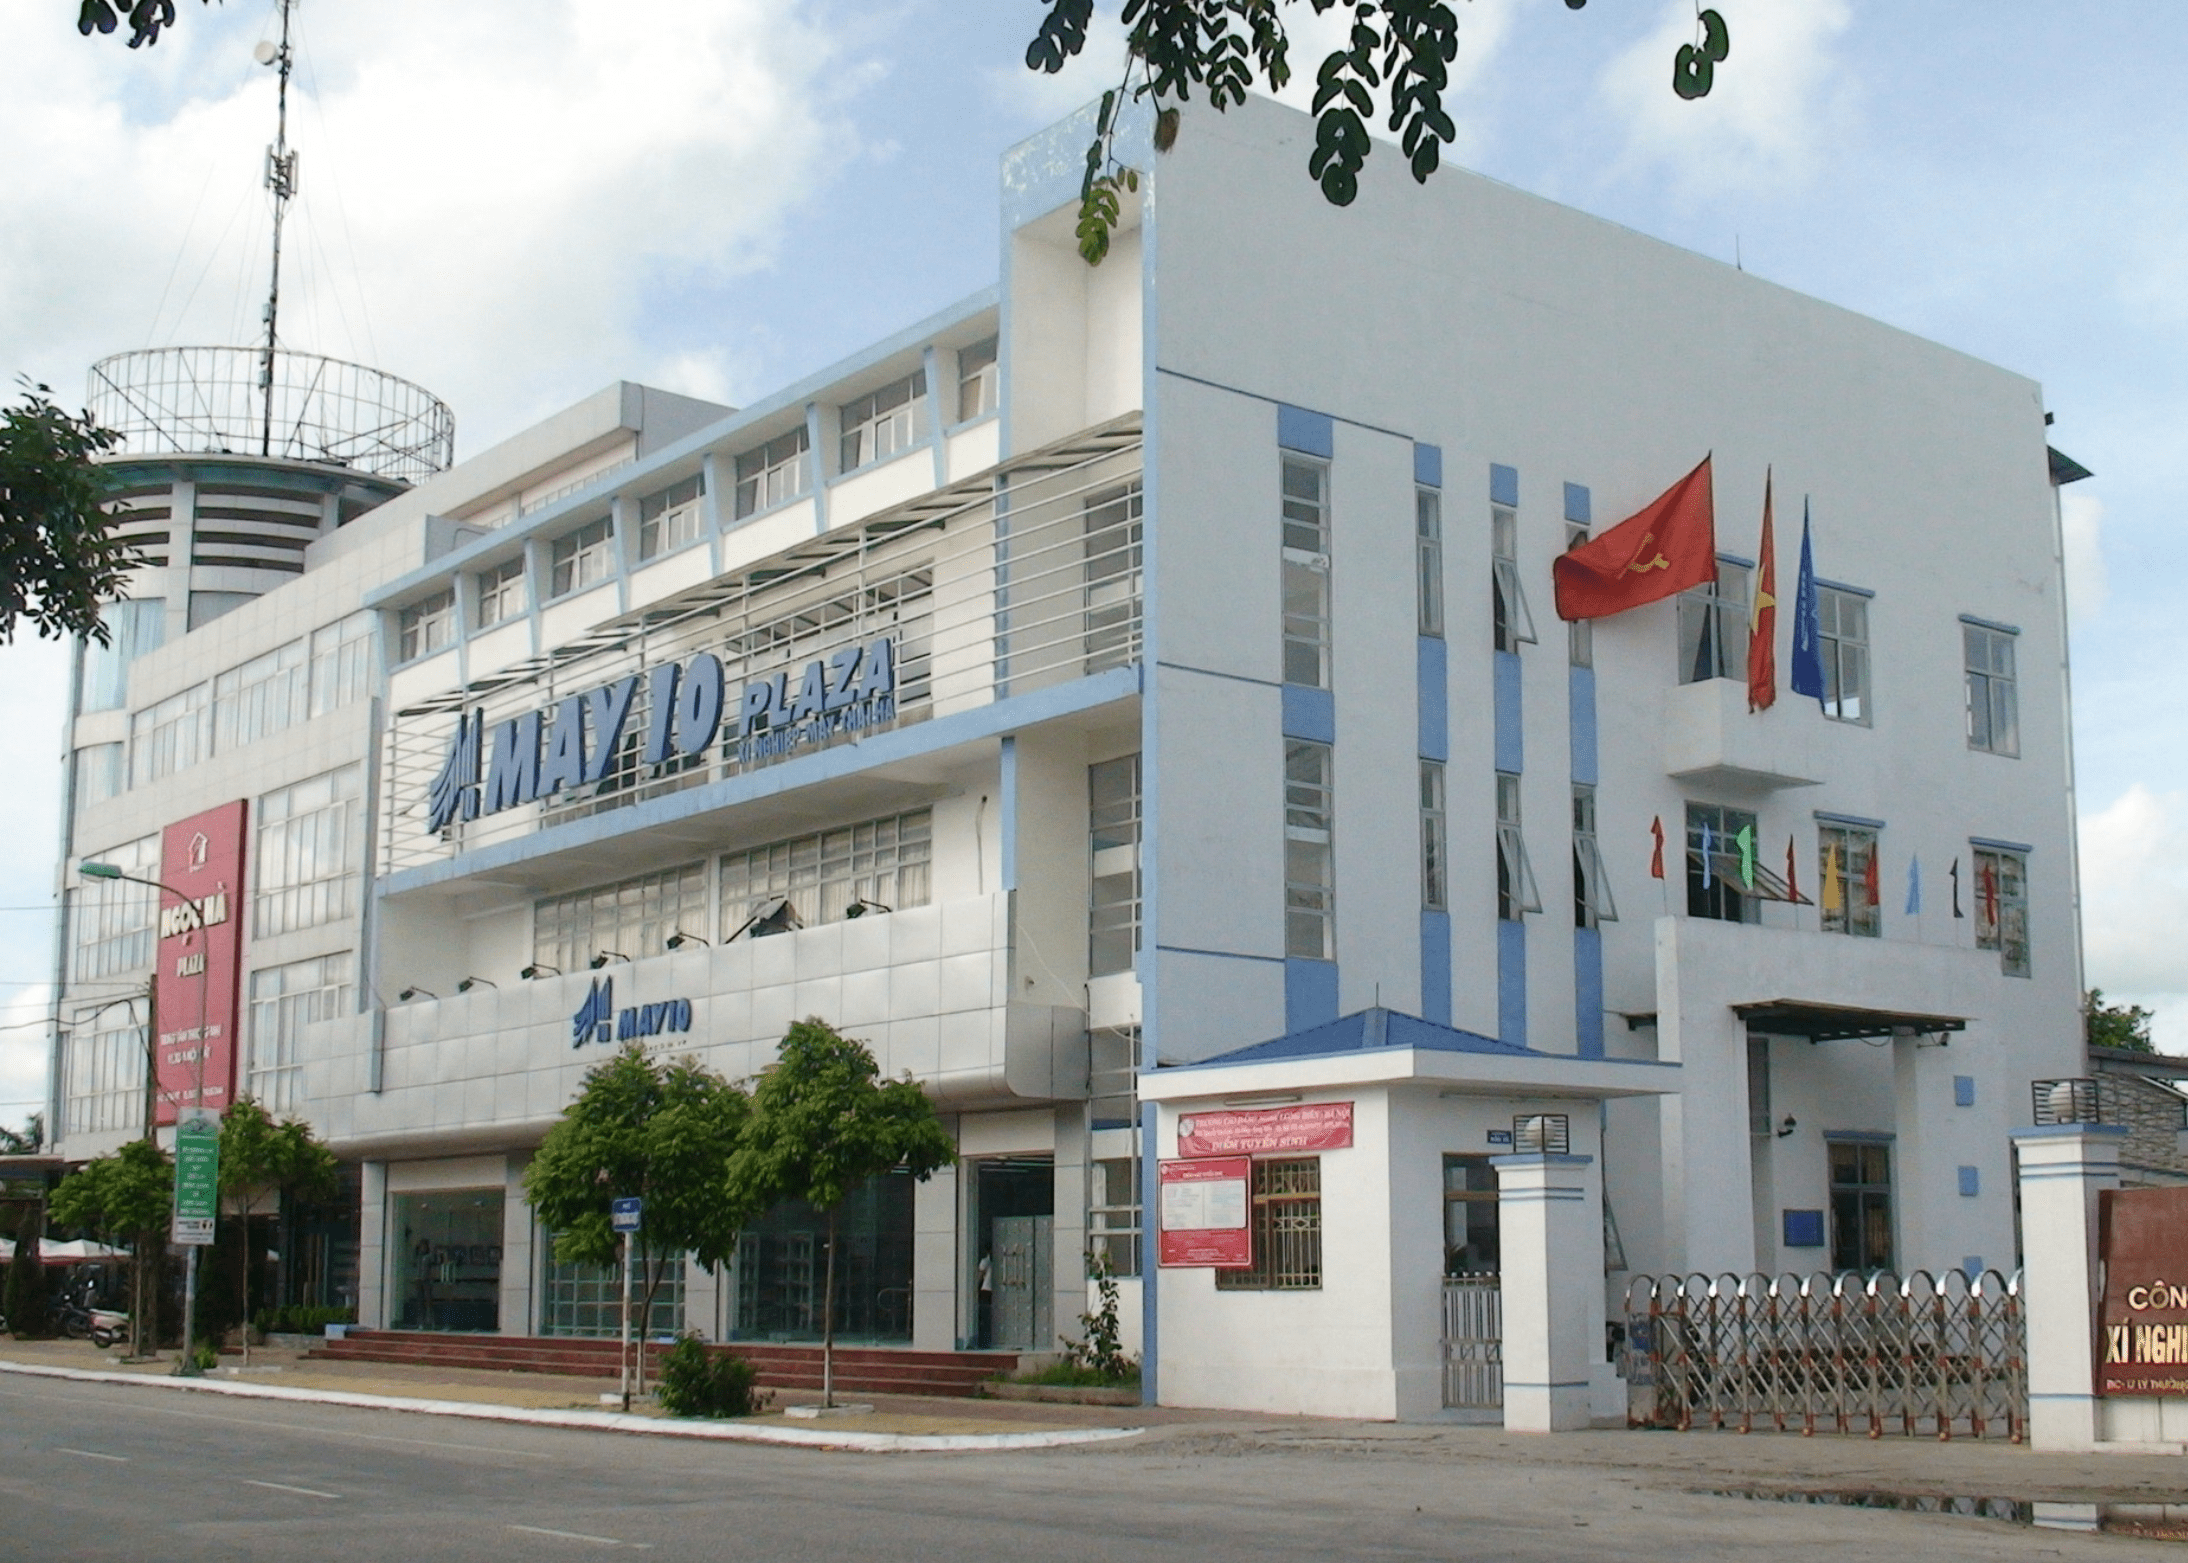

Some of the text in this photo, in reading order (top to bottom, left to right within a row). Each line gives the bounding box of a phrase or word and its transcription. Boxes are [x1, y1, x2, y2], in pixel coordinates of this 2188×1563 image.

[484, 638, 894, 815] MAY 10 PLAZA
[2106, 1317, 2129, 1364] XÍ
